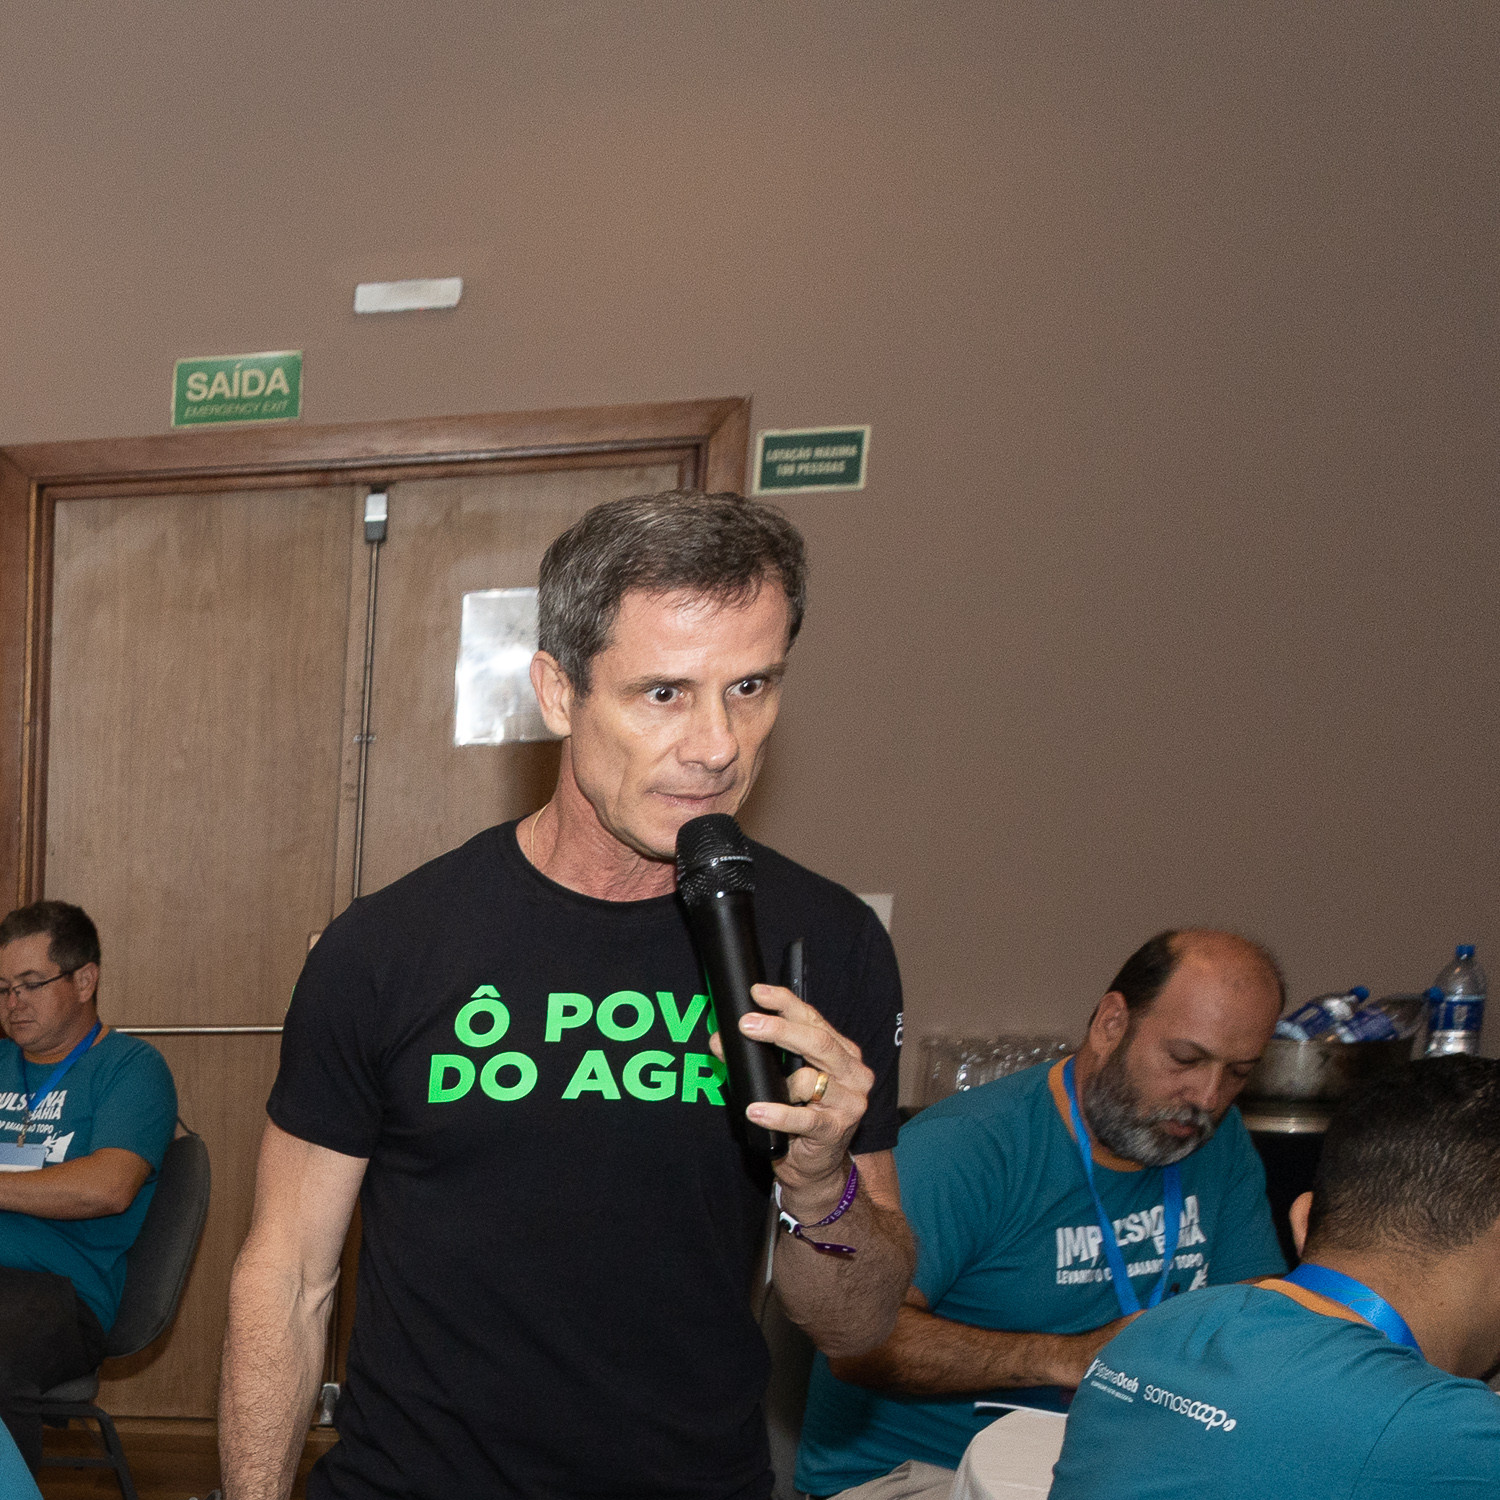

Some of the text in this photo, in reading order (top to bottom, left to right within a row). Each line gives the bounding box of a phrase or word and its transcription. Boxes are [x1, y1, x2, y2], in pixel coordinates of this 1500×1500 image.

[186, 362, 290, 401] SAÍDA
[454, 984, 720, 1048] Ô POV
[427, 1049, 728, 1107] DO AGR
[35, 1123, 55, 1134] TOPO
